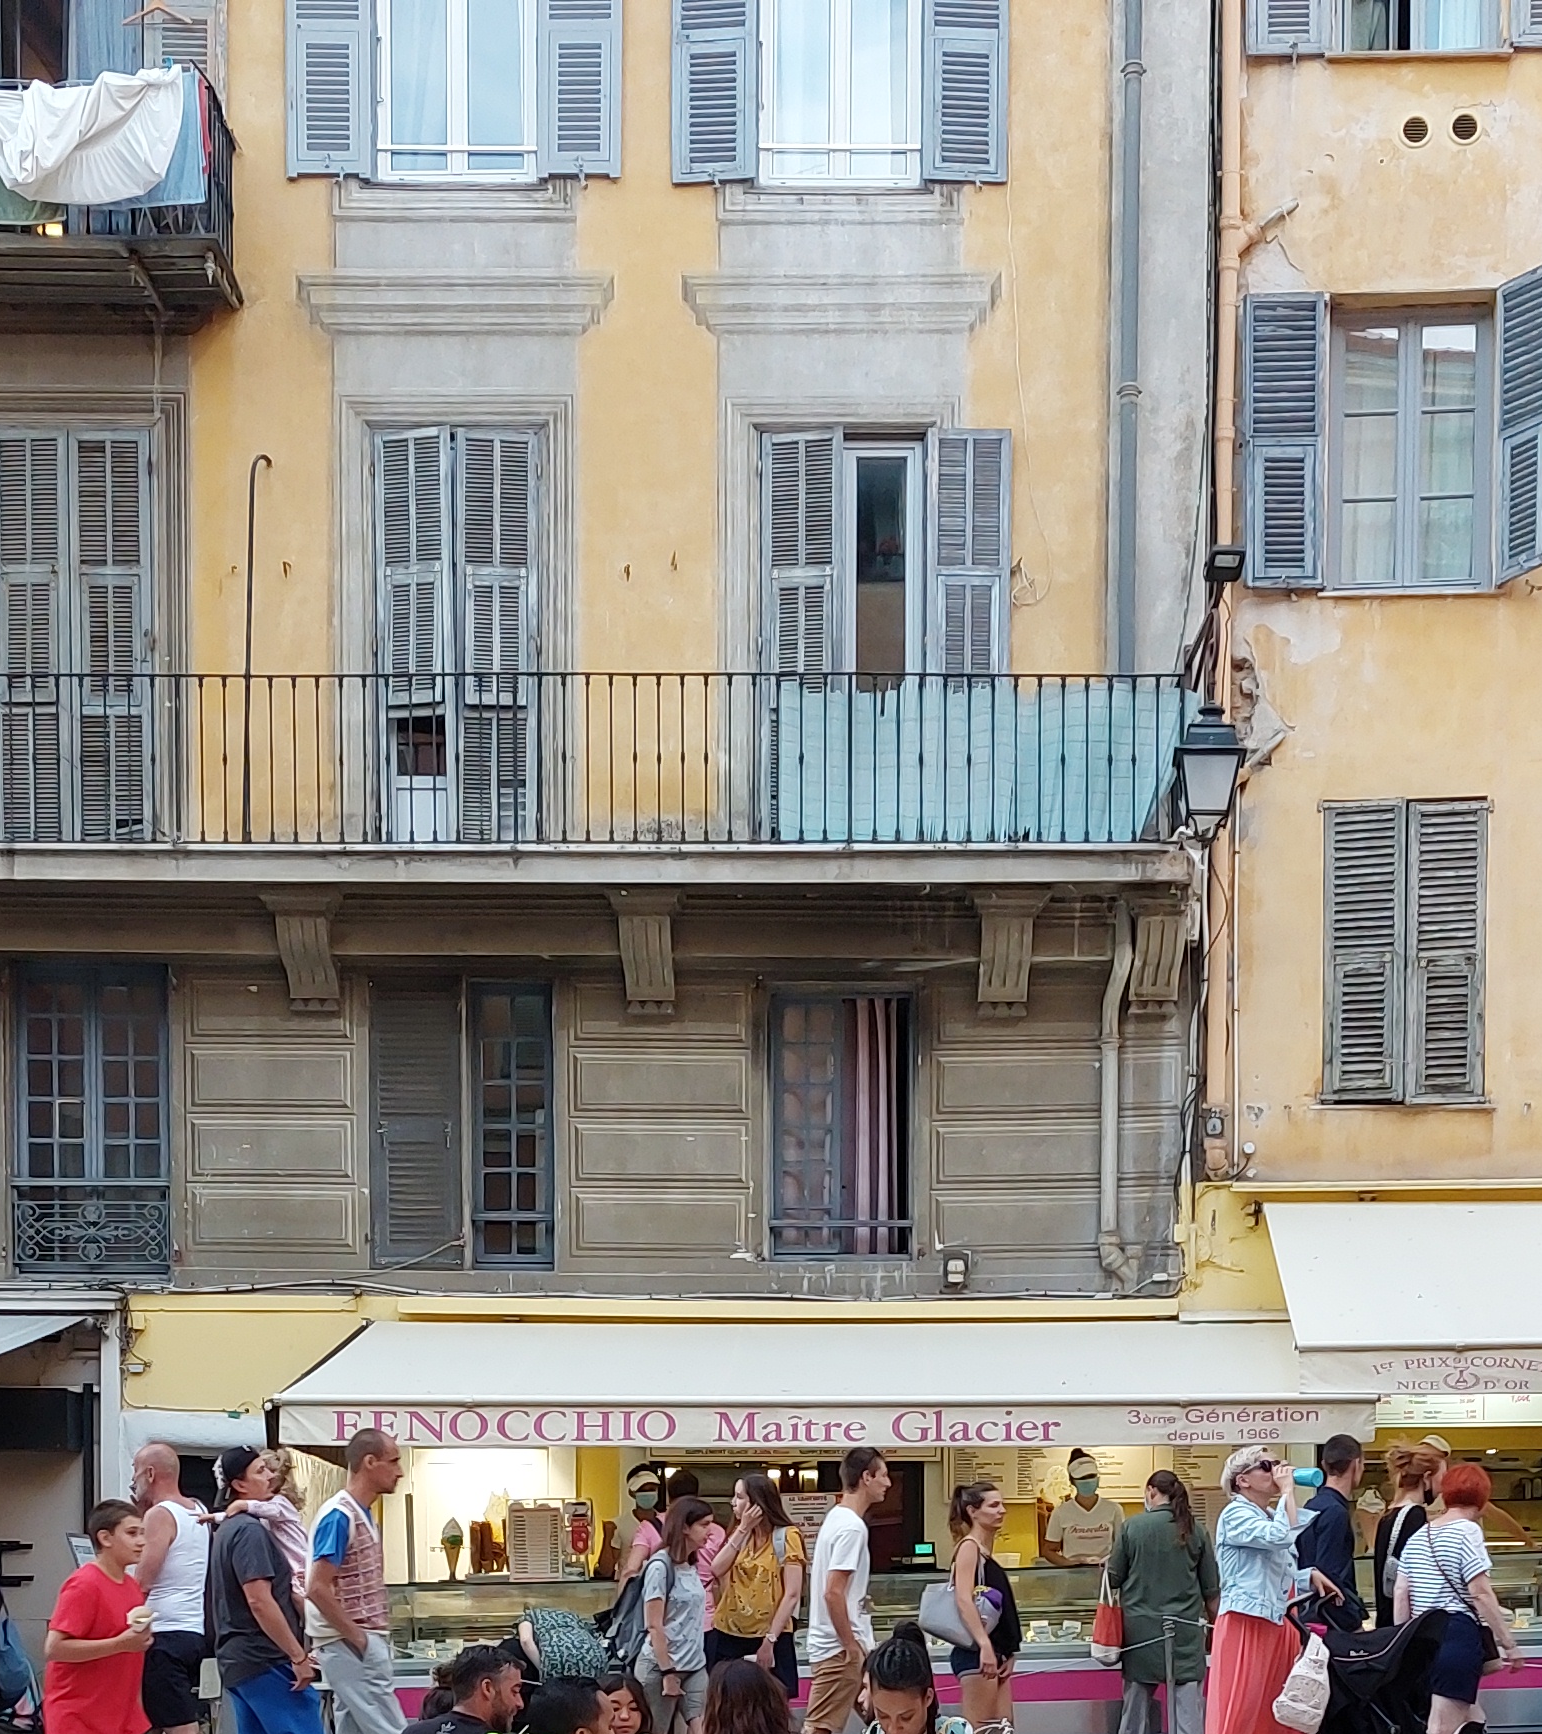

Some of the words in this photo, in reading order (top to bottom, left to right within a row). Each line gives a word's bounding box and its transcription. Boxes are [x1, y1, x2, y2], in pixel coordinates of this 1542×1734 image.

[1404, 1356, 1453, 1369] PRIX
[1396, 1380, 1441, 1391] NICE
[1185, 1407, 1320, 1424] Génération
[331, 1409, 677, 1442] FENOCCHIO
[712, 1411, 867, 1442] Maître
[891, 1409, 1062, 1442] Glacier
[1167, 1429, 1225, 1443] depuis
[1237, 1428, 1280, 1440] 1966
